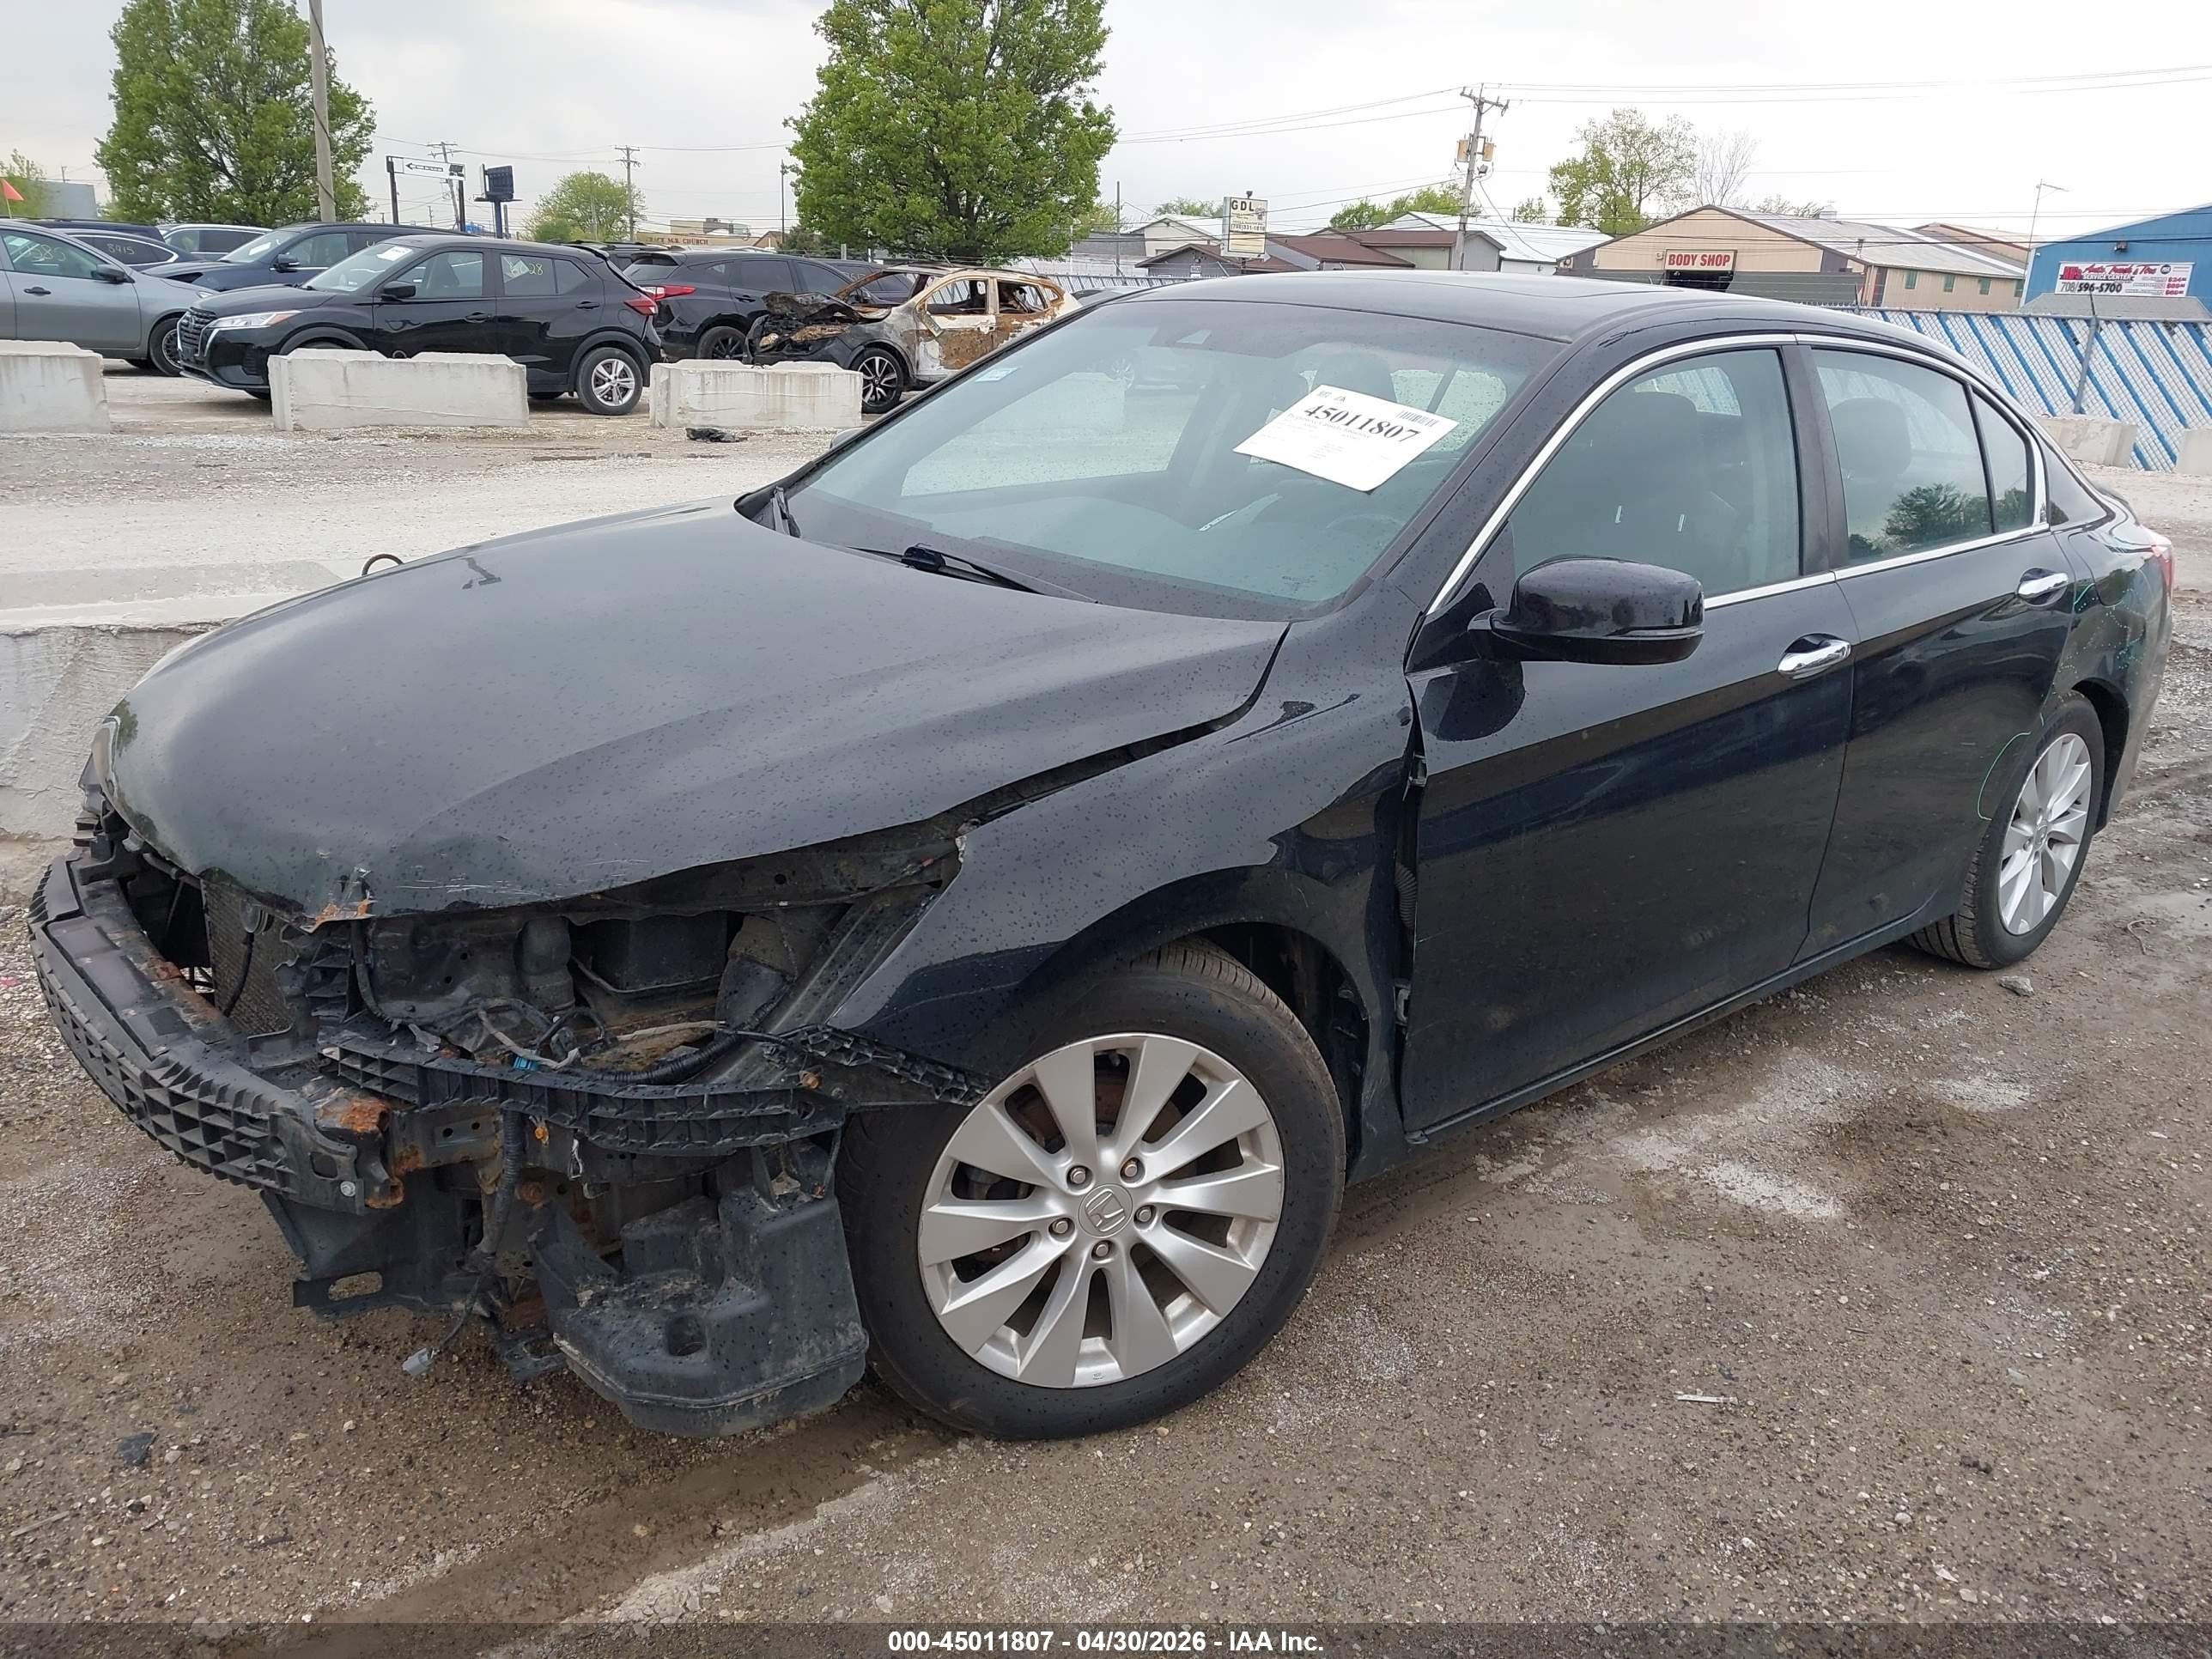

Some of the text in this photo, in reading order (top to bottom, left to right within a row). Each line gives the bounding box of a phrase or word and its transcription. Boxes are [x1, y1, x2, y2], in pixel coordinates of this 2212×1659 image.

[1231, 200, 1255, 211] GDL
[1668, 254, 1730, 266] BODY SHOP
[1304, 404, 1422, 443] 45011807
